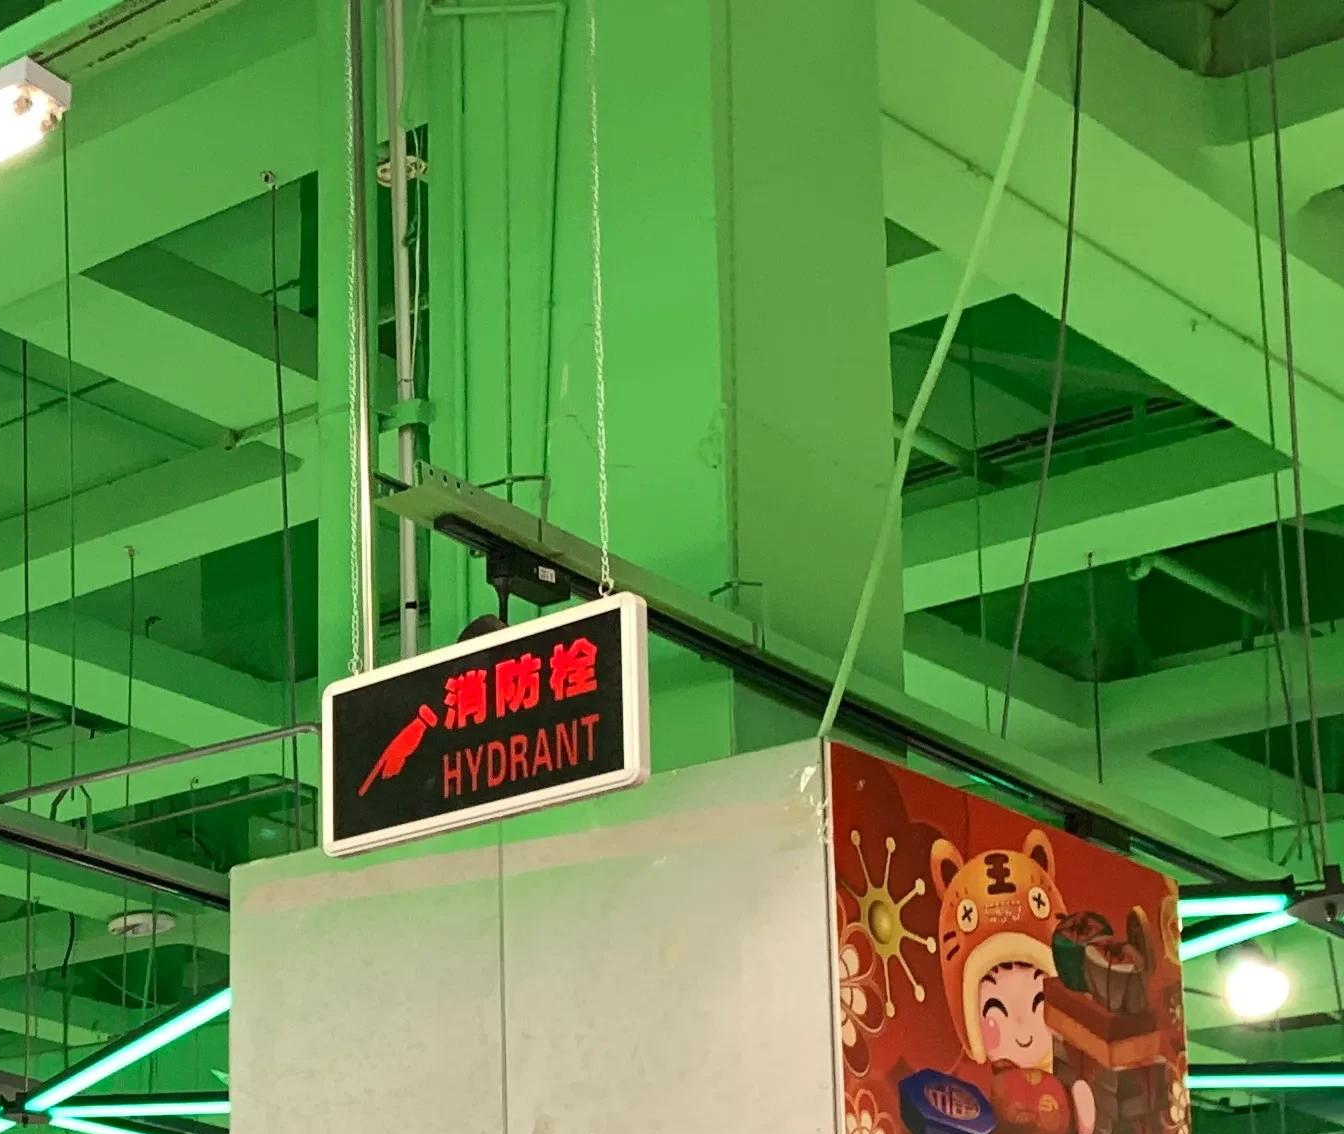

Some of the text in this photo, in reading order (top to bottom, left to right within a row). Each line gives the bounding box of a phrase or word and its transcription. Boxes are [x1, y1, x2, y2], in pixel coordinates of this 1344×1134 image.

[443, 636, 599, 730] 消防栓
[442, 713, 600, 800] HYDRANT
